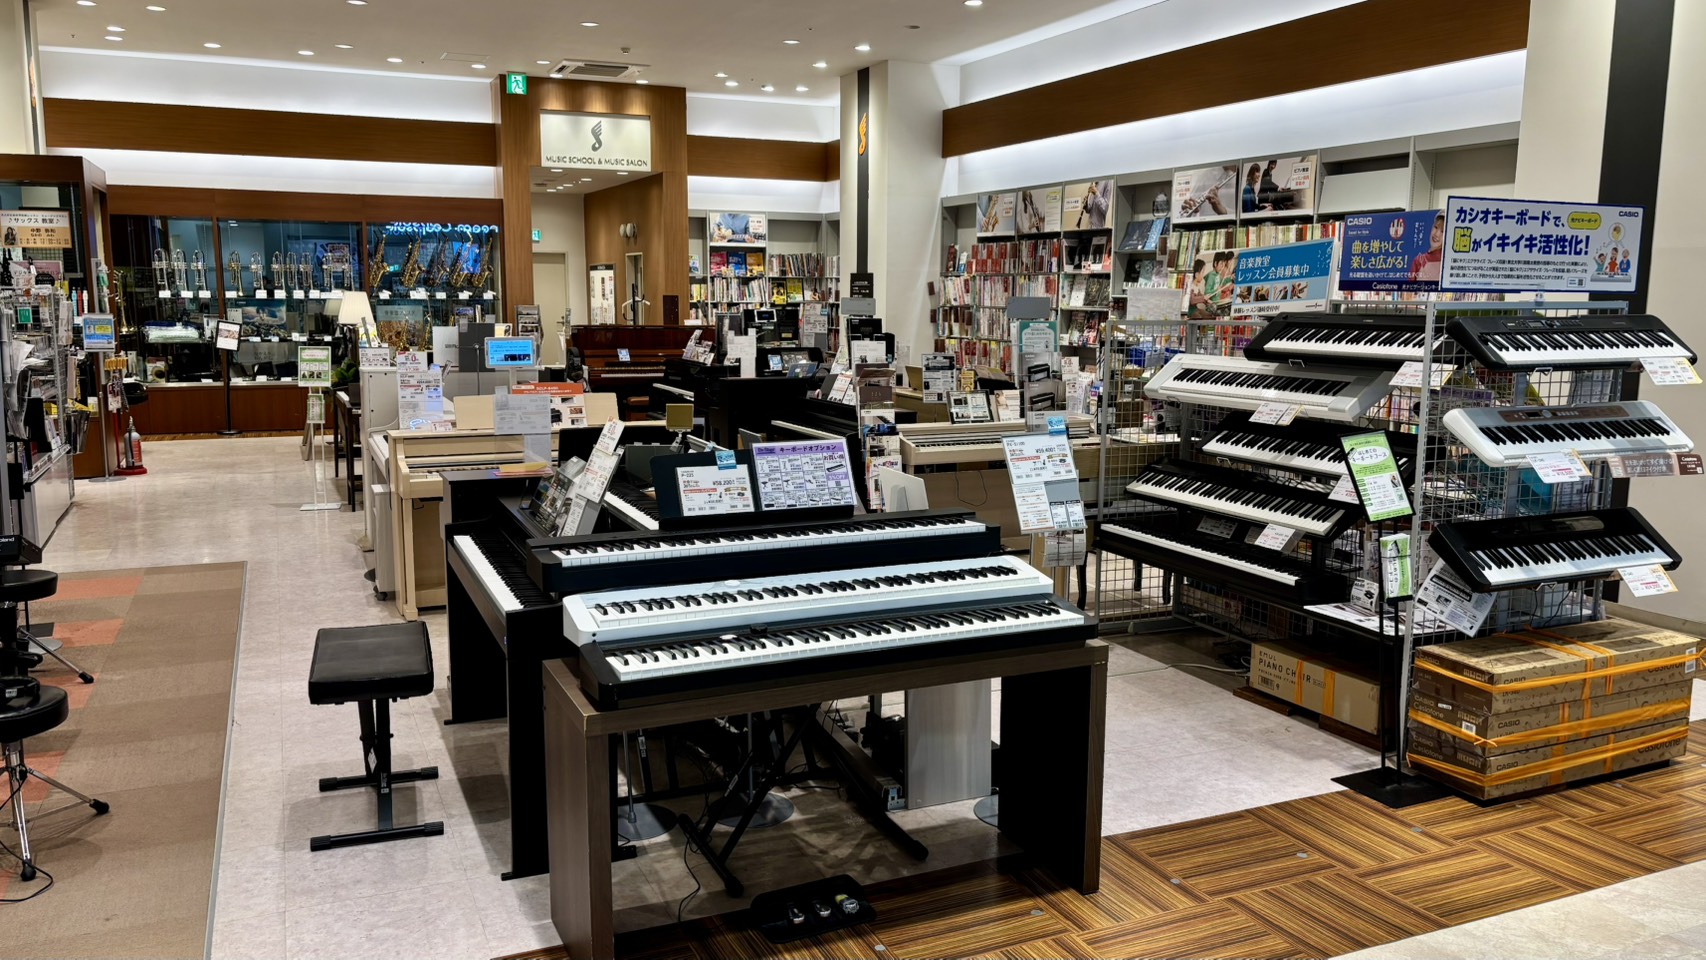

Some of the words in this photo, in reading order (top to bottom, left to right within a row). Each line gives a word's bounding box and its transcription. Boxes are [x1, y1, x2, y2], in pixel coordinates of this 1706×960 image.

[546, 156, 567, 164] MUSIC
[569, 156, 596, 165] SCHOOL
[604, 158, 625, 166] MUSIC
[626, 159, 648, 167] SALON
[1455, 206, 1565, 228] カシオキーボードで、
[1618, 210, 1639, 218] CASIO
[1347, 217, 1373, 226] CASIO
[1351, 239, 1404, 254] 曲を増やして
[1239, 255, 1271, 270] 音楽教室
[1350, 255, 1408, 269] 楽しさ広がる!
[1237, 263, 1310, 282] レッスン会員募集中
[1372, 282, 1398, 290] Casiotone
[779, 444, 837, 453] キーボードオプション
[1259, 651, 1277, 661] EMUL
[1258, 658, 1282, 673] PIANO
[1286, 667, 1311, 683] CHIR
[1415, 694, 1435, 707] CASIO
[1413, 702, 1444, 719] Casiotone
[1497, 719, 1521, 729] CASIO
[1412, 743, 1444, 761] Casiotone
[1497, 761, 1519, 771] CASIO
